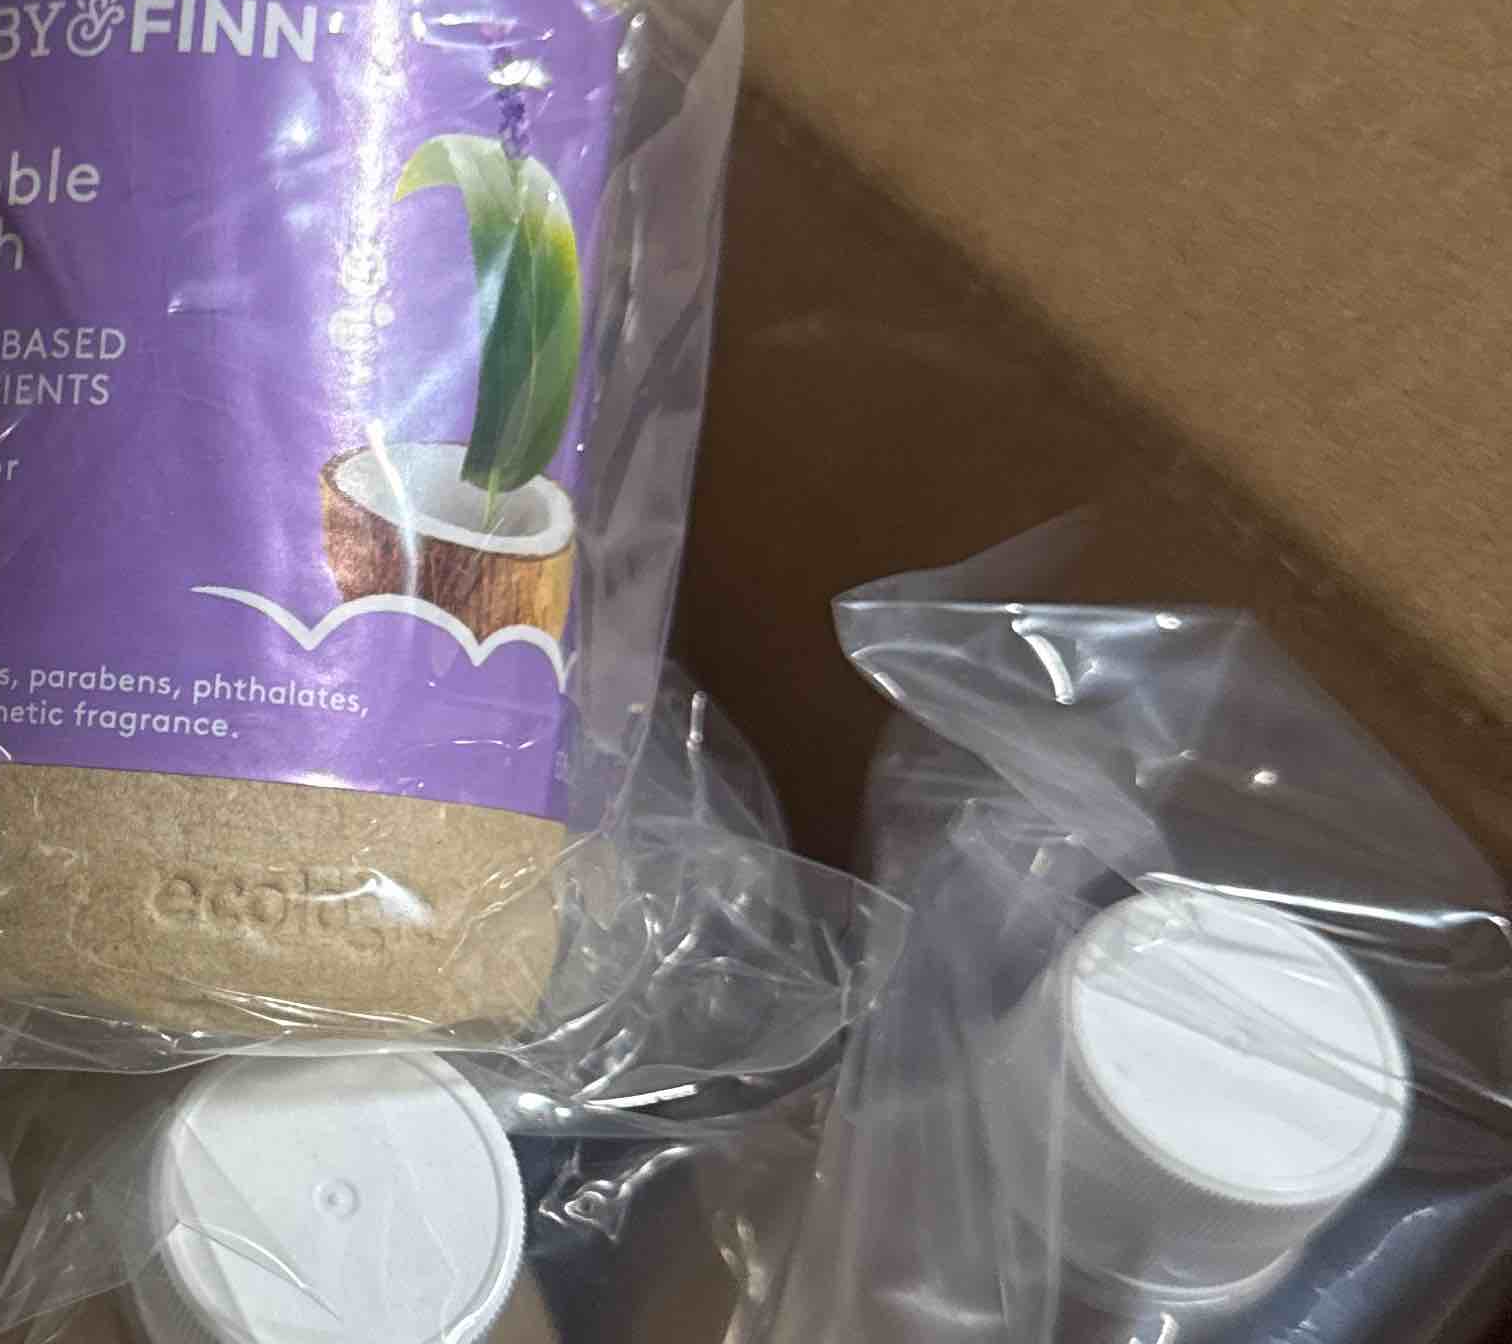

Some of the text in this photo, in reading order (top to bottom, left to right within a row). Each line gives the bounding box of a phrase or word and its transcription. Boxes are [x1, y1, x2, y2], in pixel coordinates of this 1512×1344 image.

[29, 665, 181, 700] parabens,
[192, 673, 369, 719] phthalates,
[73, 701, 239, 739] fragrance.
